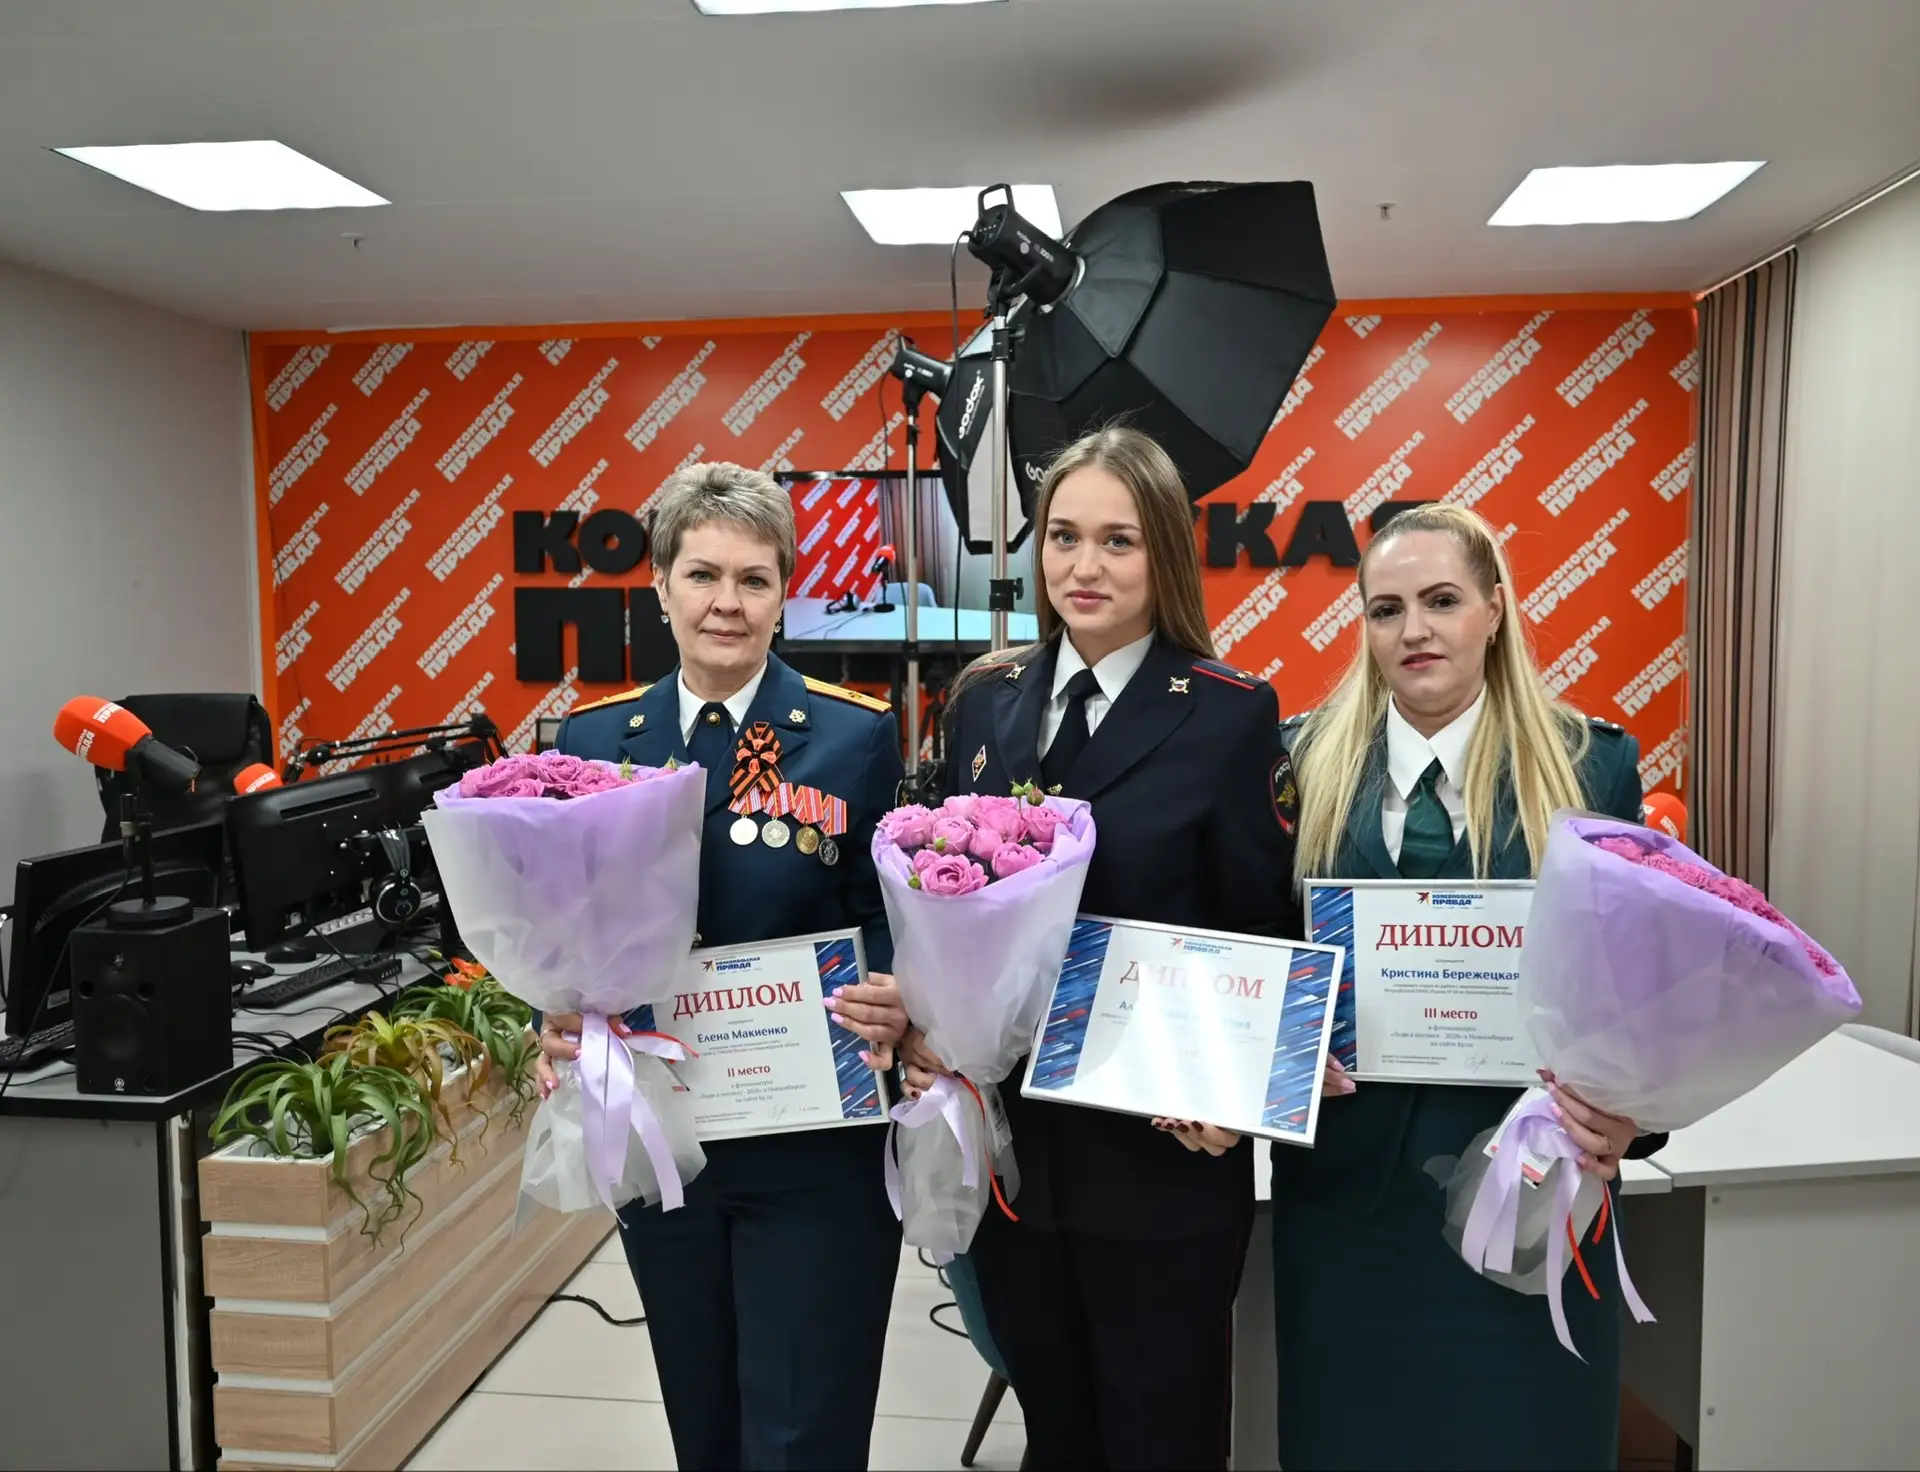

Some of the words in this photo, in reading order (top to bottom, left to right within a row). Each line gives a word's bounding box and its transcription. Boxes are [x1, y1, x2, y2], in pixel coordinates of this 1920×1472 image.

[452, 340, 495, 382] ПРА
[728, 354, 806, 437] ПРАВДА
[820, 328, 901, 410] КОМСОМОЛЬС
[1342, 352, 1431, 440] ПРАВДА
[1453, 337, 1542, 424] ПРАВДА
[1564, 320, 1656, 408] ПРАВДА
[442, 401, 516, 483] ПРАВДА
[536, 387, 610, 468] ПРАВДА
[632, 371, 707, 452] ПРАВДА
[351, 417, 422, 496] ПРАВДА
[1545, 430, 1636, 517] ПРАВДА
[341, 517, 412, 595] ПРАВДА
[432, 504, 504, 582] ПРАВДА
[1528, 540, 1618, 624] ПРАВДА
[332, 616, 403, 693] ПРАВДА
[424, 602, 496, 680] ПРАВДА
[1376, 924, 1524, 952] ДИПЛОМ
[1381, 968, 1440, 982] Кристина
[1442, 968, 1520, 982] Бережецкая
[672, 980, 804, 1021] ДИПЛОМ
[698, 1032, 730, 1044] Елена
[732, 1025, 788, 1040] Макиенко
[1424, 1008, 1437, 1018] III
[1440, 1010, 1478, 1020] место
[727, 1068, 736, 1078] II
[738, 1064, 771, 1076] место
